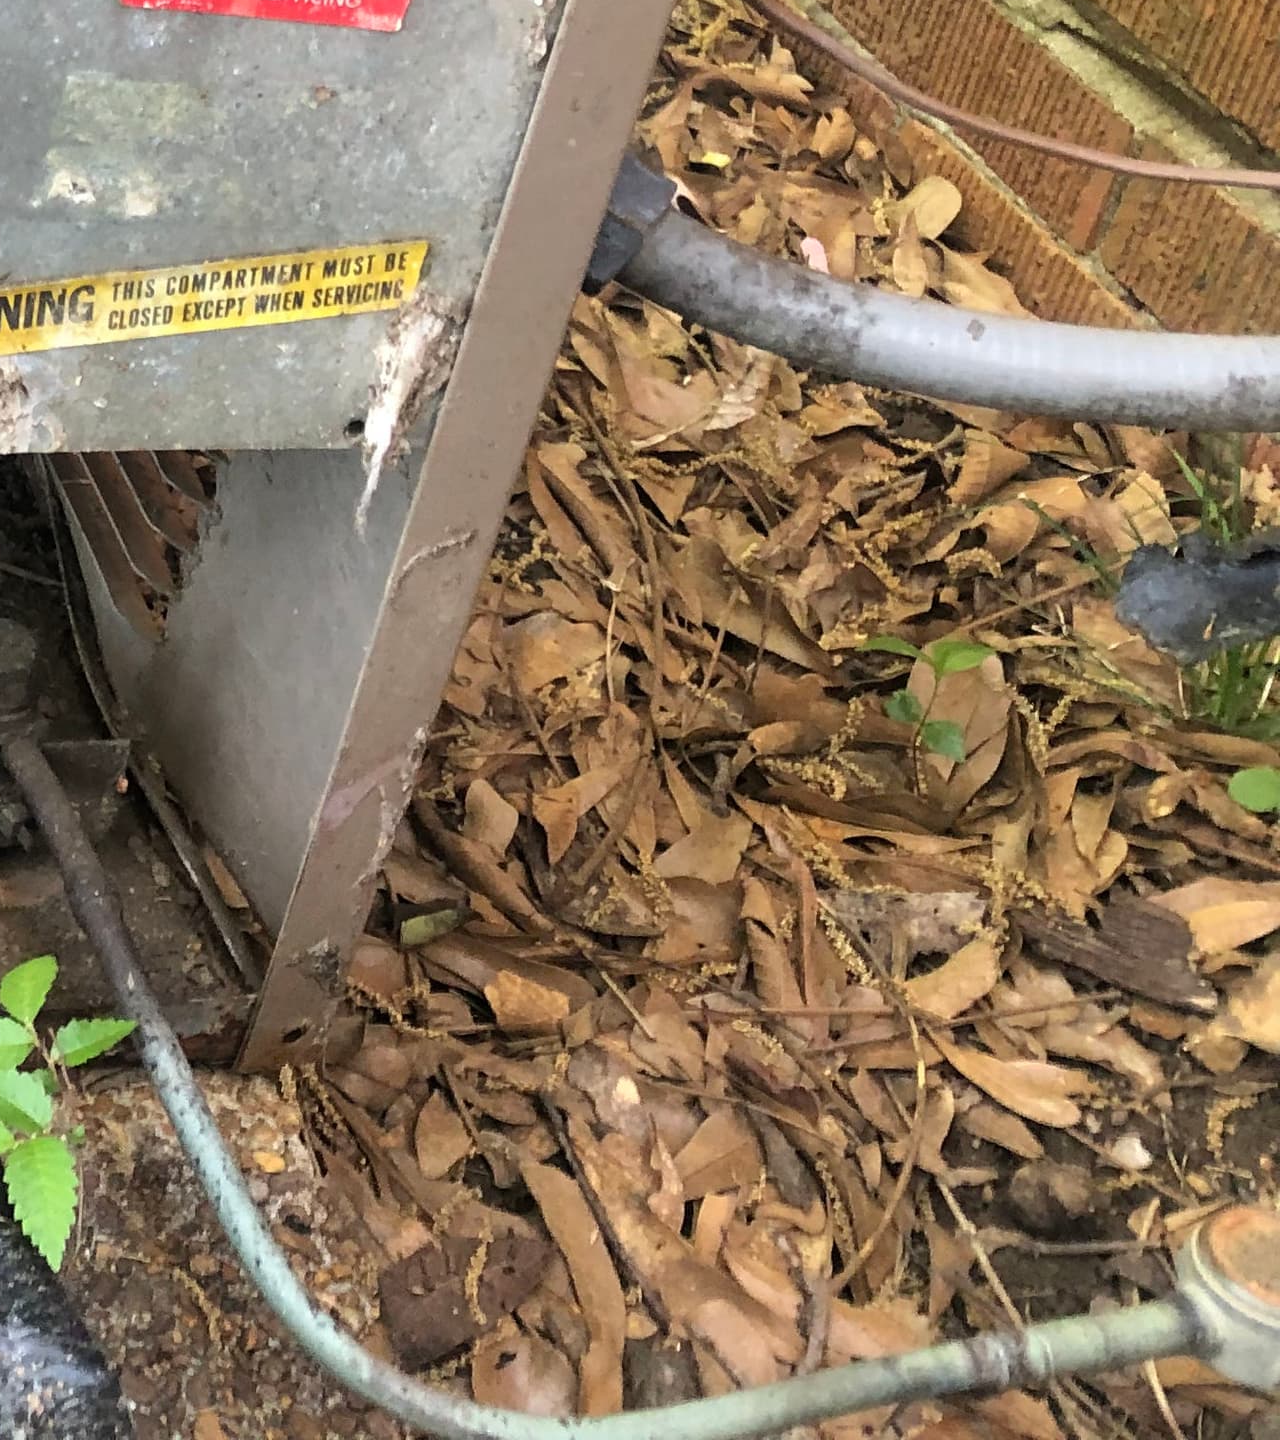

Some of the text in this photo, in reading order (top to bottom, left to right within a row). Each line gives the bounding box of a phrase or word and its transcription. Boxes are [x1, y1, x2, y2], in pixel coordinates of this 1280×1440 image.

[112, 251, 409, 302] THIS COMPARTMENT MUST BE
[108, 279, 404, 330] CLOSED EXCEPT WHEN SERVICING
